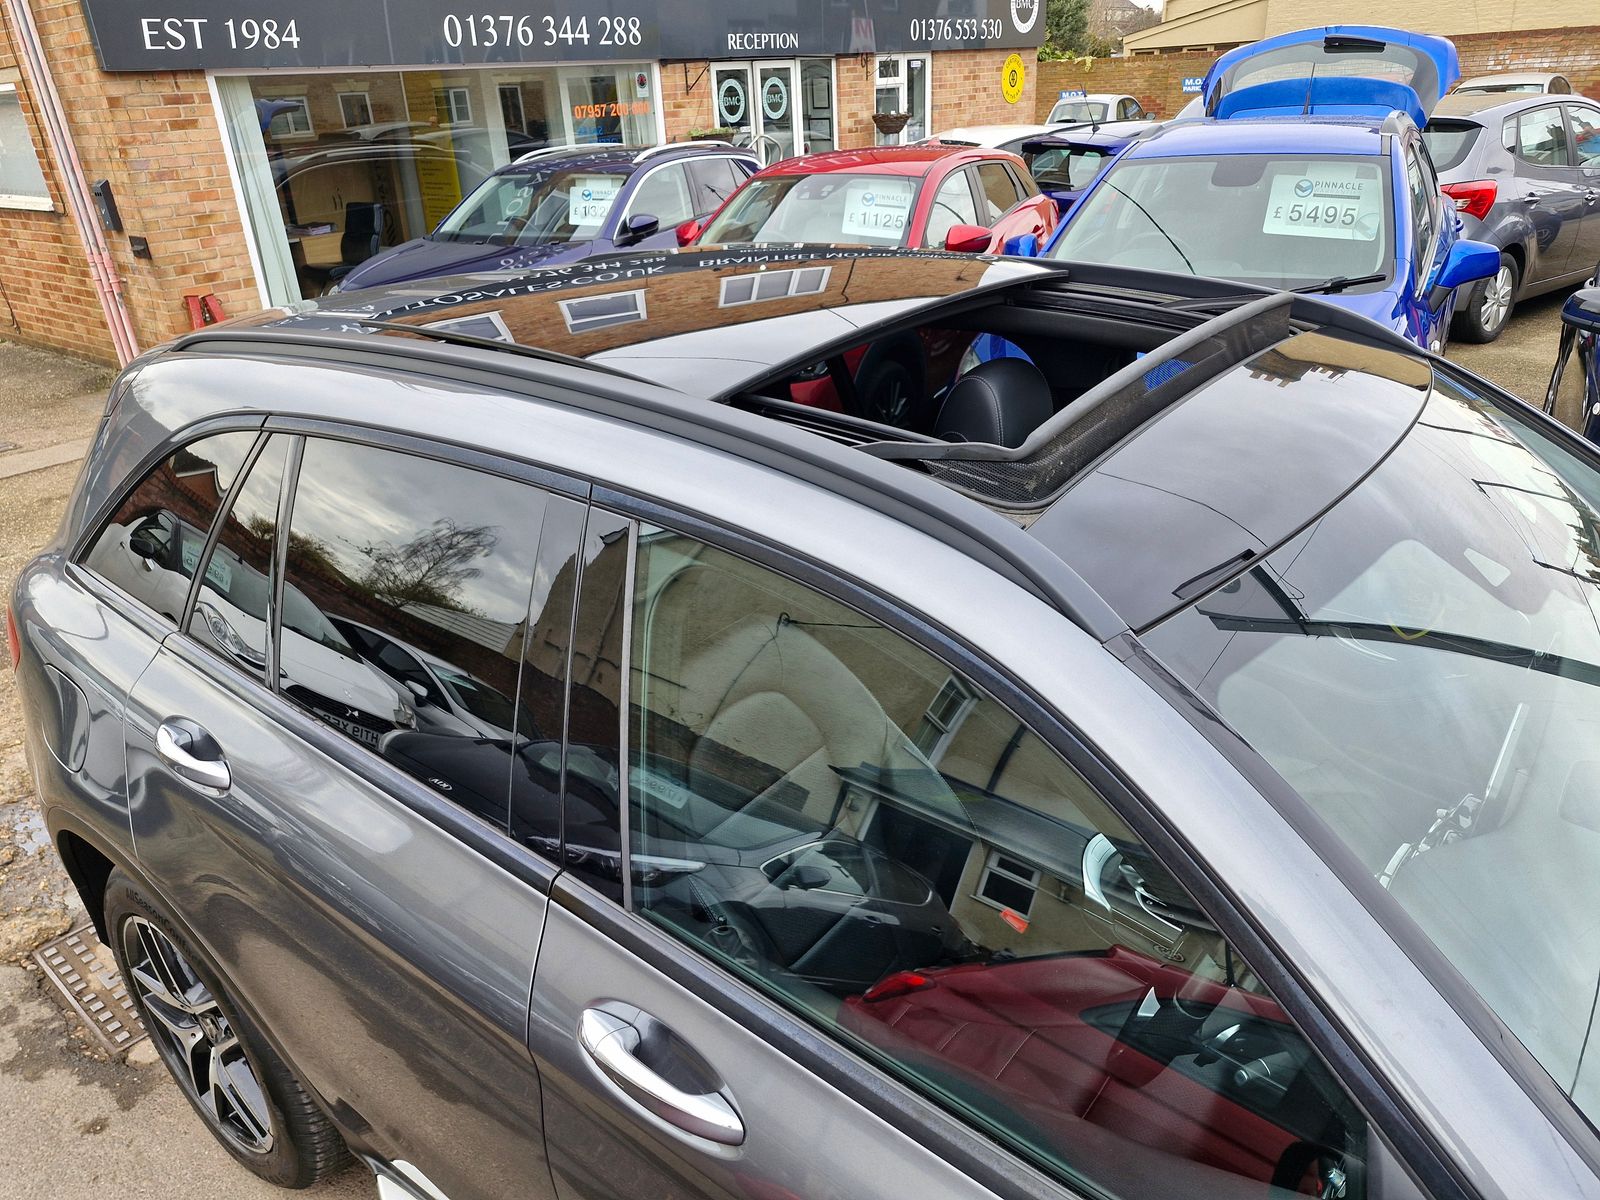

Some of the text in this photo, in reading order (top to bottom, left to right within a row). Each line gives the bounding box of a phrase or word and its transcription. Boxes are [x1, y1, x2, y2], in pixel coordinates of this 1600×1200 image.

[141, 18, 301, 50] EST 1984
[443, 14, 642, 47] 01376 344 288
[910, 18, 1003, 42] 01376 553 530
[727, 32, 799, 50] RECEPTION
[1184, 78, 1205, 86] M.O.
[723, 95, 741, 107] BMC
[767, 93, 784, 104] BMC
[574, 104, 607, 119] 07957
[1314, 180, 1364, 191] PINNACLE
[1288, 204, 1357, 226] 5495
